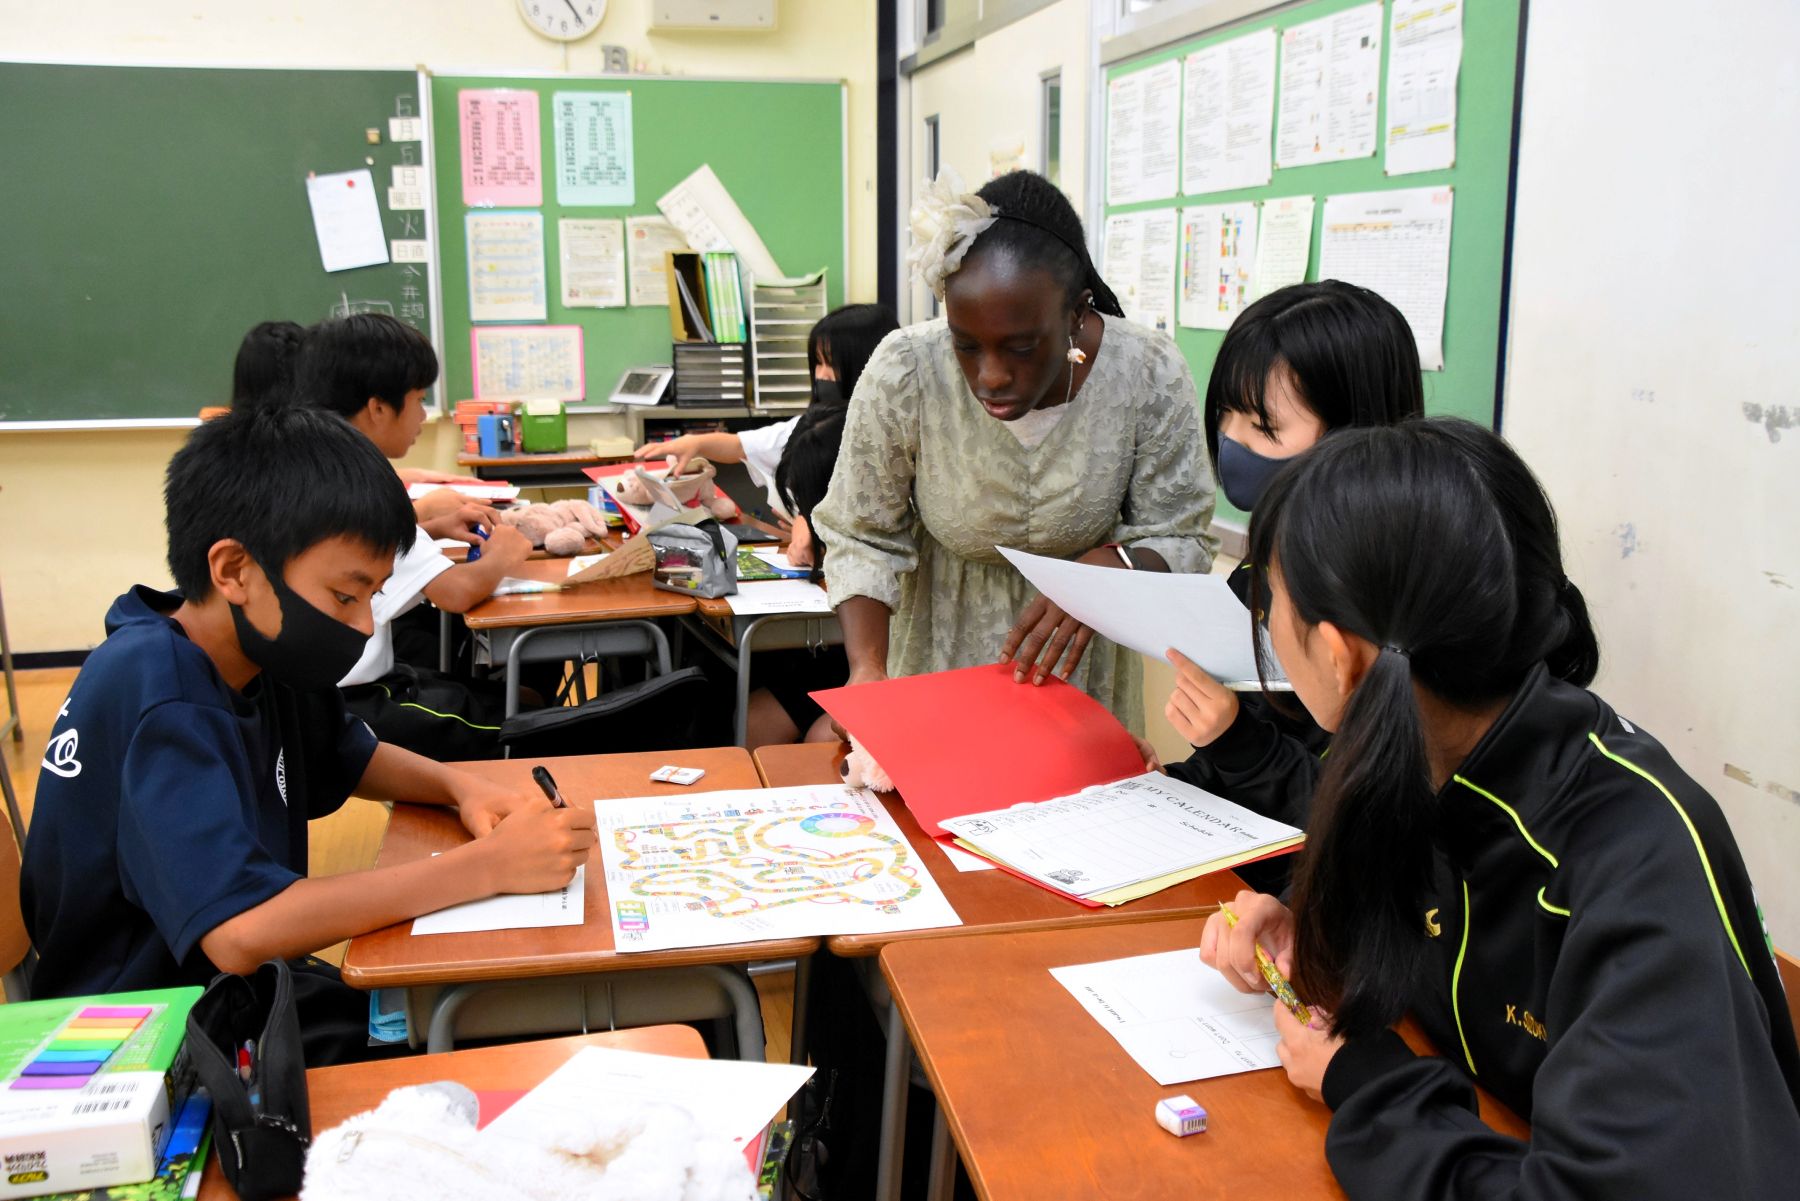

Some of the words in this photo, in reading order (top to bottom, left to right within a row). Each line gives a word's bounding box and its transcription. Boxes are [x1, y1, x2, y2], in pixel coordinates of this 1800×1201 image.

[547, 16, 553, 27] 7
[561, 21, 568, 32] 6
[601, 45, 629, 73] B
[1166, 796, 1242, 833] CALENDAR
[617, 901, 649, 931] LIFE
